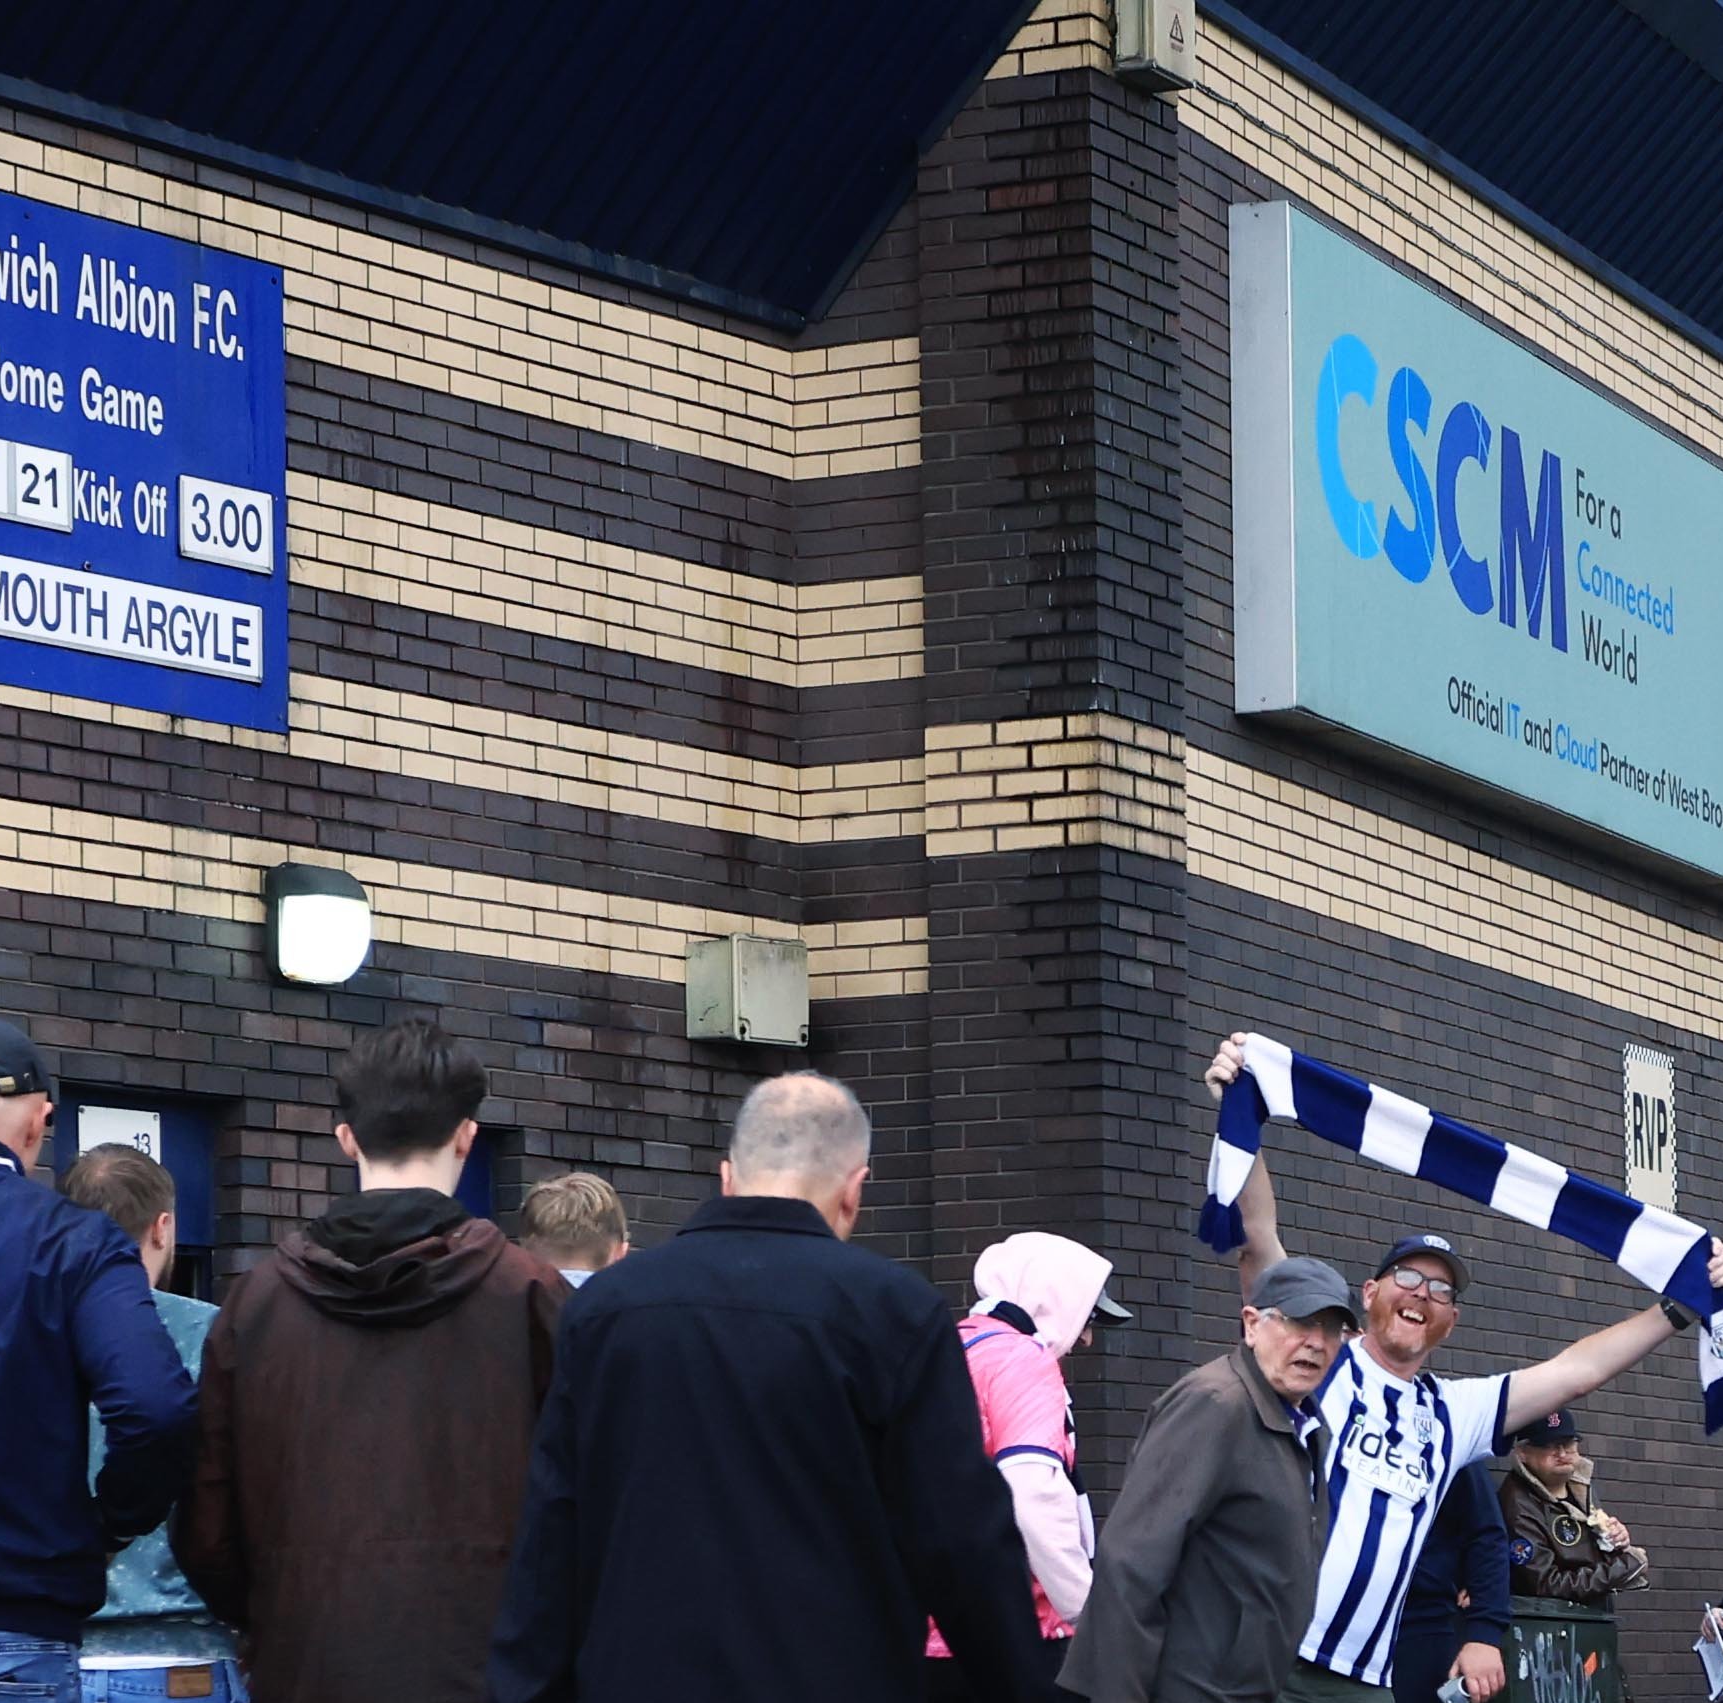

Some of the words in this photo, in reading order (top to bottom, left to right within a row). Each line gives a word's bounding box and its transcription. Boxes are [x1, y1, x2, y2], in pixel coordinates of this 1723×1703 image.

[75, 254, 176, 344] Albion
[192, 281, 245, 362] F.C.
[80, 367, 164, 436] Game
[20, 462, 59, 509] 21
[73, 476, 123, 530] Kick
[133, 487, 167, 538] Off
[190, 491, 262, 553] 3.00
[1316, 333, 1569, 654] CSCM
[1575, 466, 1606, 527] For
[1609, 507, 1622, 540] a
[1577, 541, 1675, 637] Connected
[121, 594, 252, 667] ARGYLE
[1581, 609, 1639, 687] World
[1447, 675, 1504, 737] Official
[1507, 701, 1521, 741] IT
[1523, 716, 1553, 757] and
[1555, 723, 1598, 774] Cloud
[1599, 739, 1650, 796] Partner
[1652, 769, 1667, 799] of
[1668, 777, 1700, 816] West
[134, 1132, 151, 1156] 13
[1633, 1091, 1668, 1173] RVP
